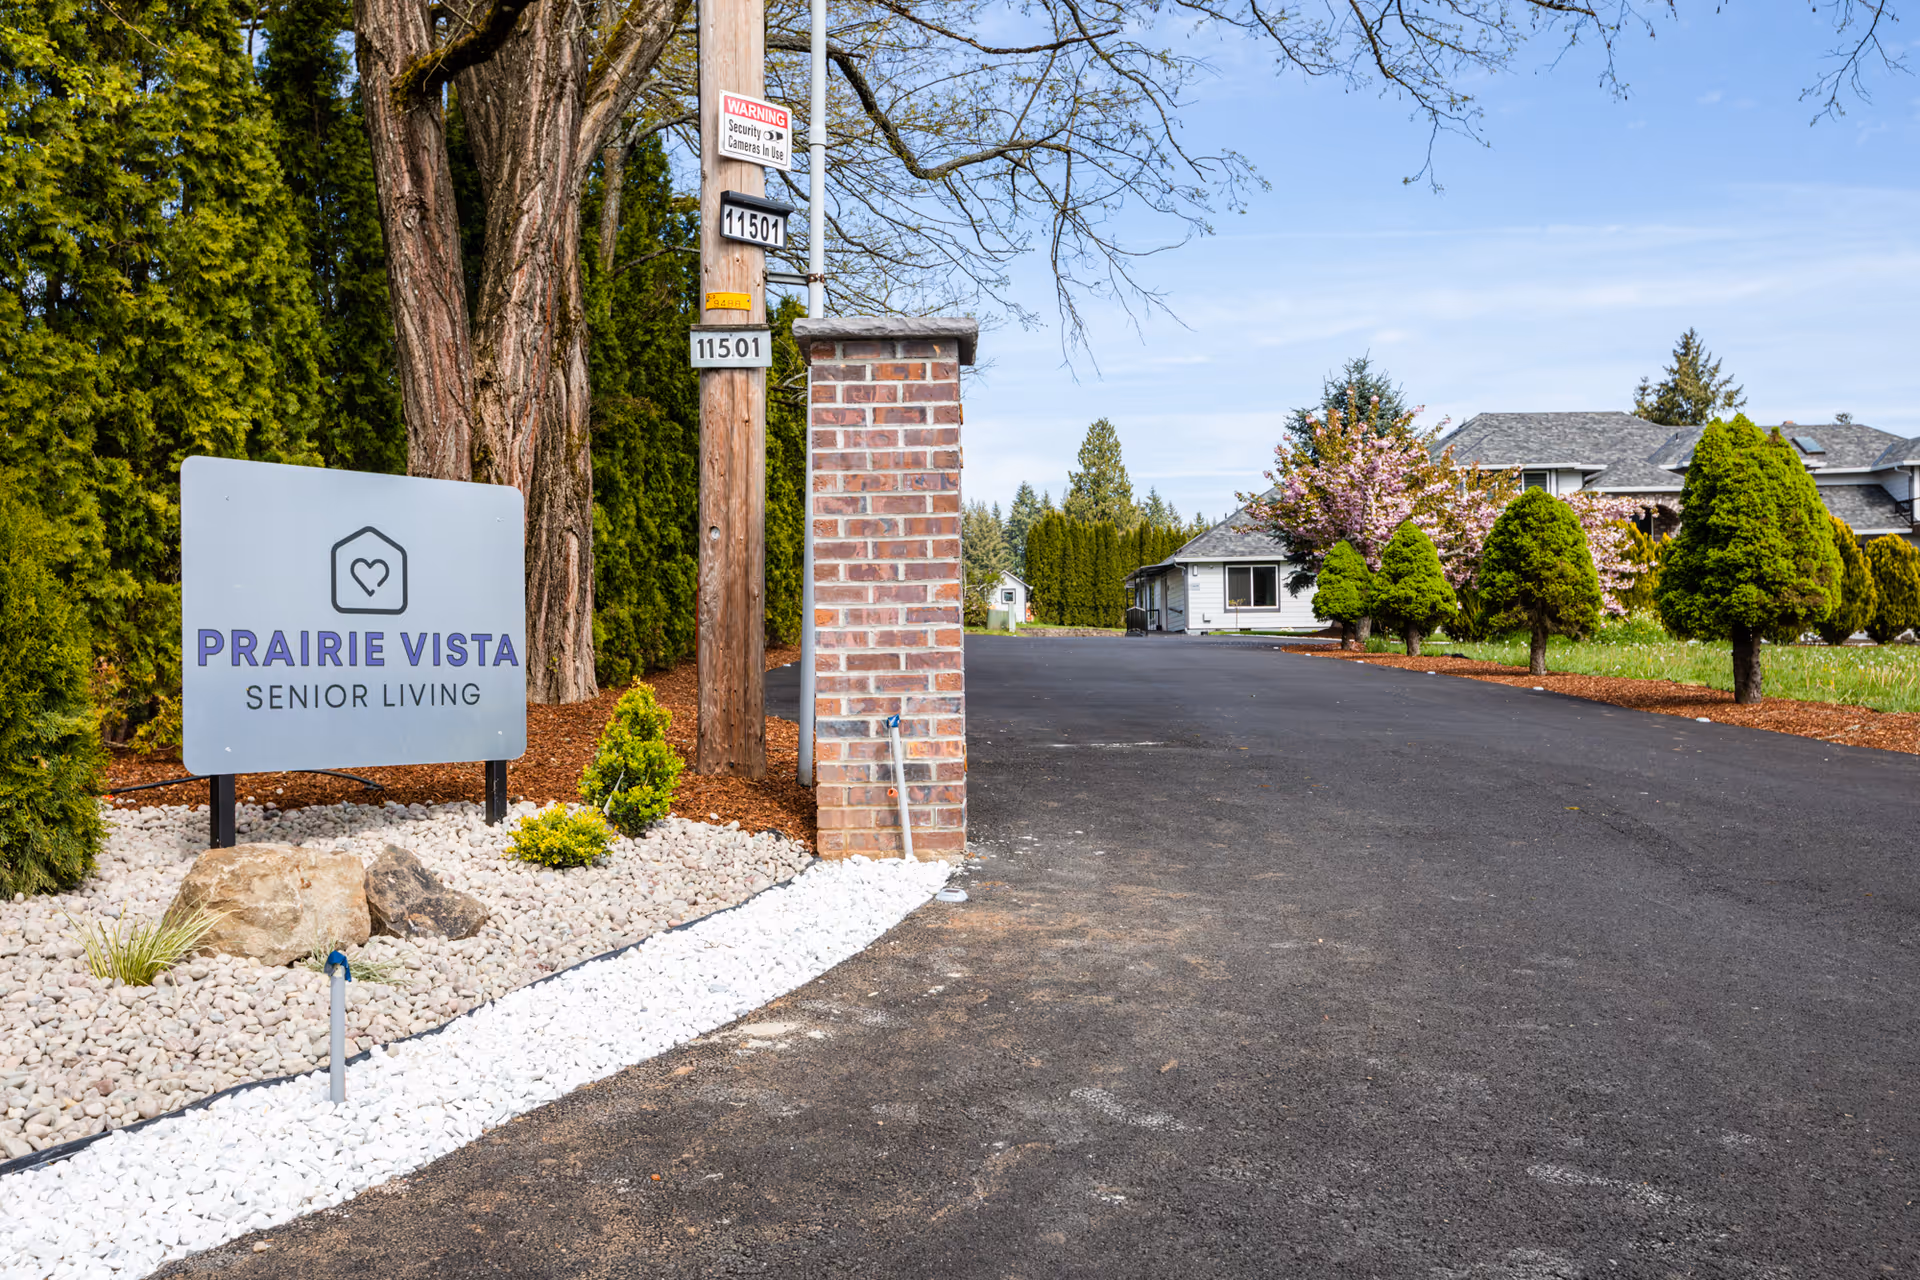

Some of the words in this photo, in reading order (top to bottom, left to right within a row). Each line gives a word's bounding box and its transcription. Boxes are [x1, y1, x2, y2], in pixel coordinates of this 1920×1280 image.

[728, 99, 785, 126] WARNING
[728, 119, 761, 141] Security
[728, 135, 760, 154] Cameras
[762, 144, 769, 156] In
[771, 146, 784, 160] Use
[726, 208, 779, 244] 11501
[697, 337, 760, 358] 11501
[197, 629, 385, 667] PRAIRIE
[400, 632, 519, 667] VISTA
[246, 684, 368, 710] SENIOR
[383, 683, 481, 707] LIVING
